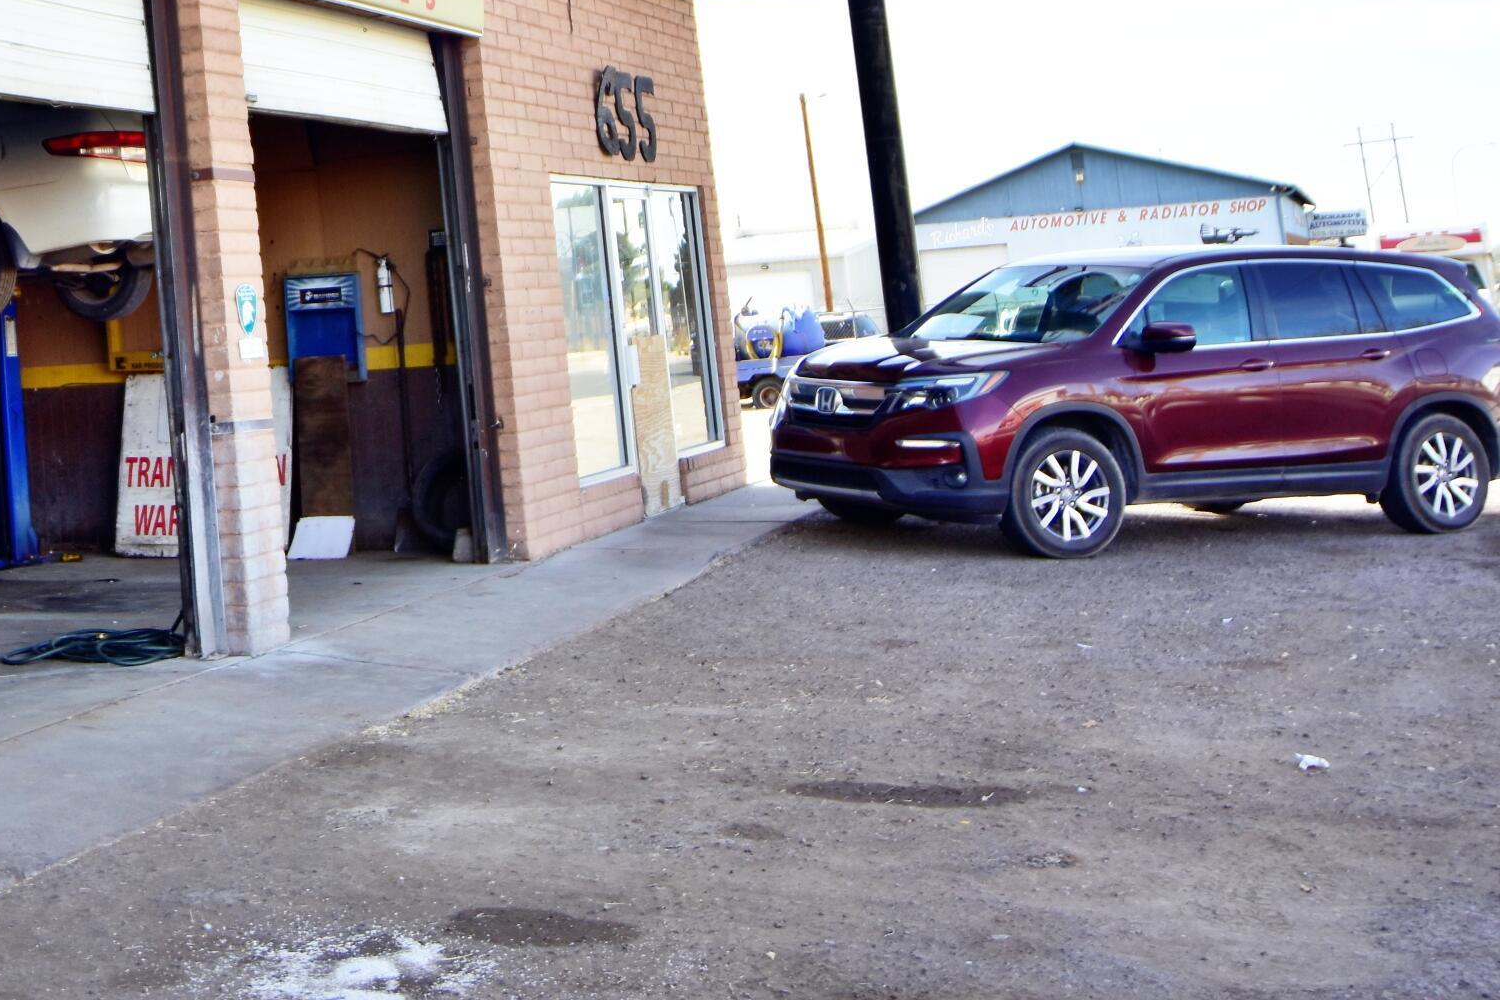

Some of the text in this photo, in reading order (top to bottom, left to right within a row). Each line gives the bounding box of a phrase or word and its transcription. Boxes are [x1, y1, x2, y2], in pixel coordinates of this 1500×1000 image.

[598, 65, 657, 162] 655
[1010, 209, 1108, 232] AUTOMOTIVE
[1117, 208, 1127, 223] &
[1139, 201, 1221, 222] RADIATOR
[1229, 198, 1268, 214] SHOP
